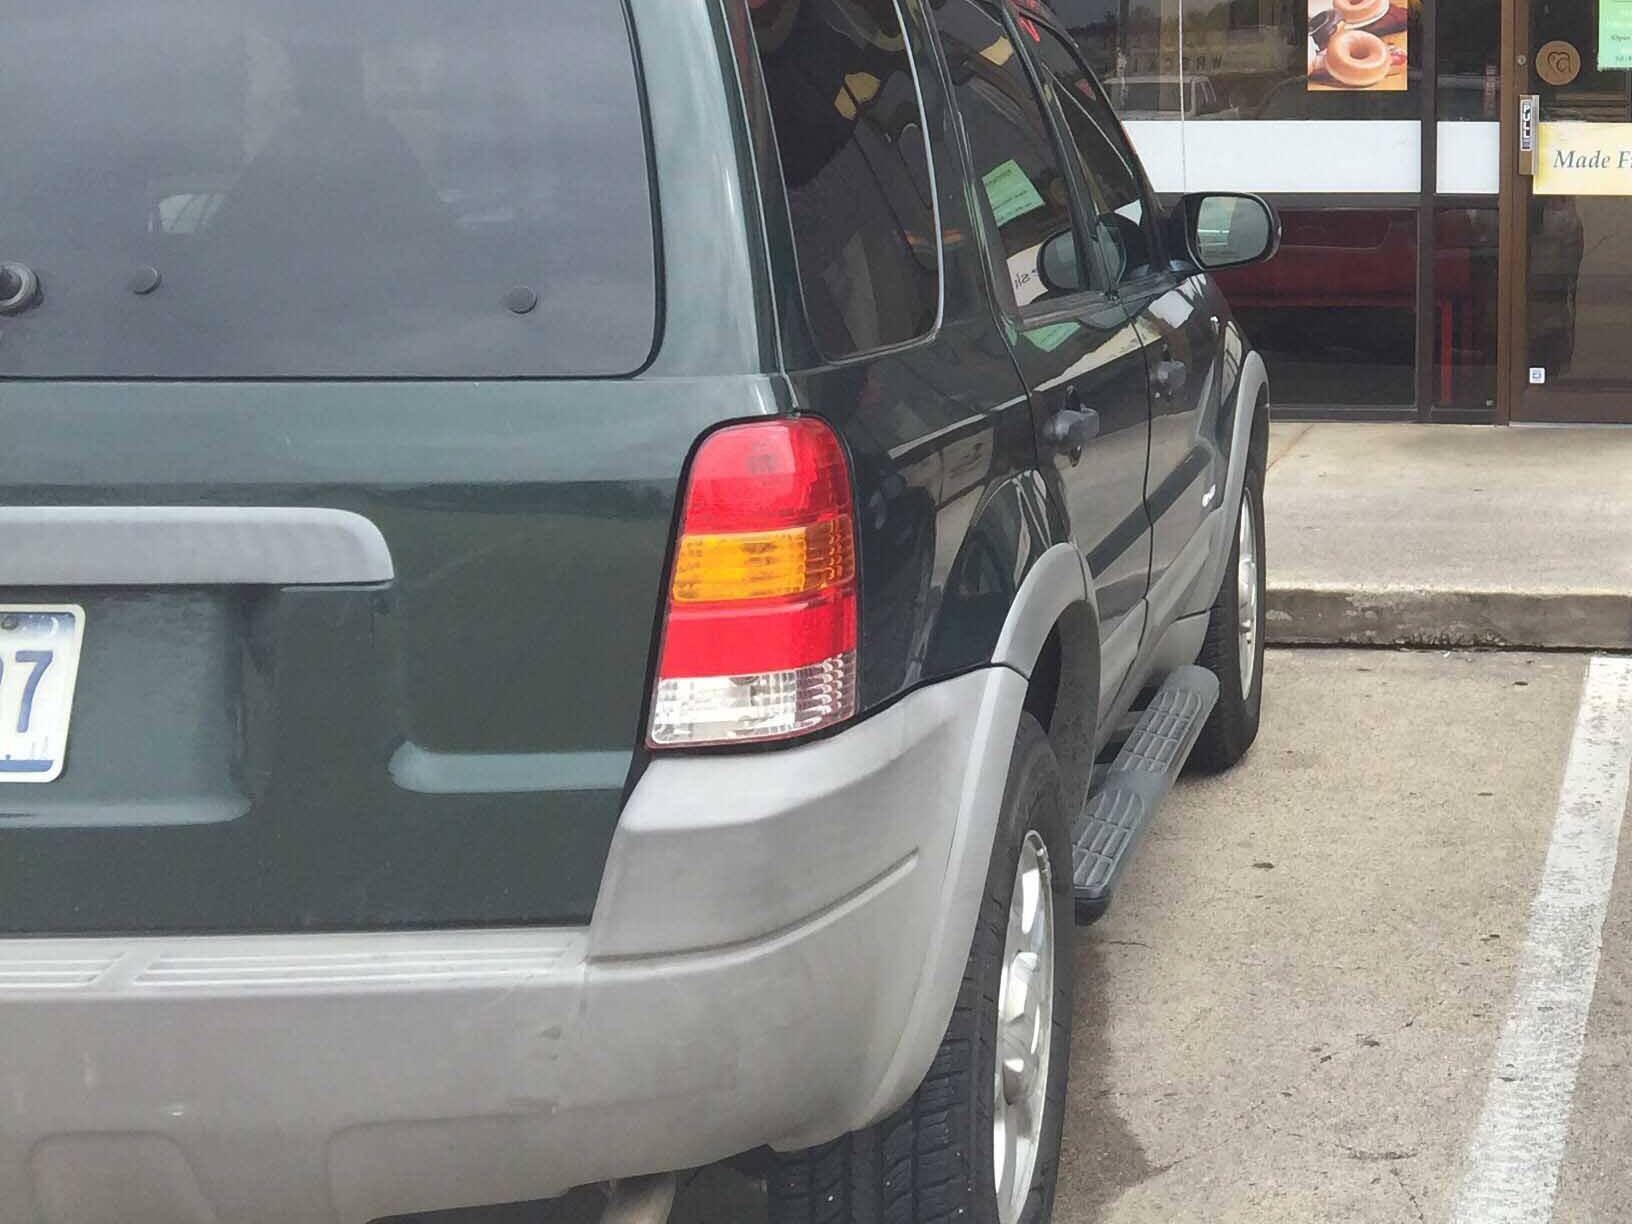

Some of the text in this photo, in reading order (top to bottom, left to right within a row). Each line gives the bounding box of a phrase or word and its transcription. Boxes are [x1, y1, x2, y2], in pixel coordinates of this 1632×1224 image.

[1522, 103, 1532, 138] PULL
[1552, 149, 1611, 169] Made
[0, 649, 54, 734] 7
